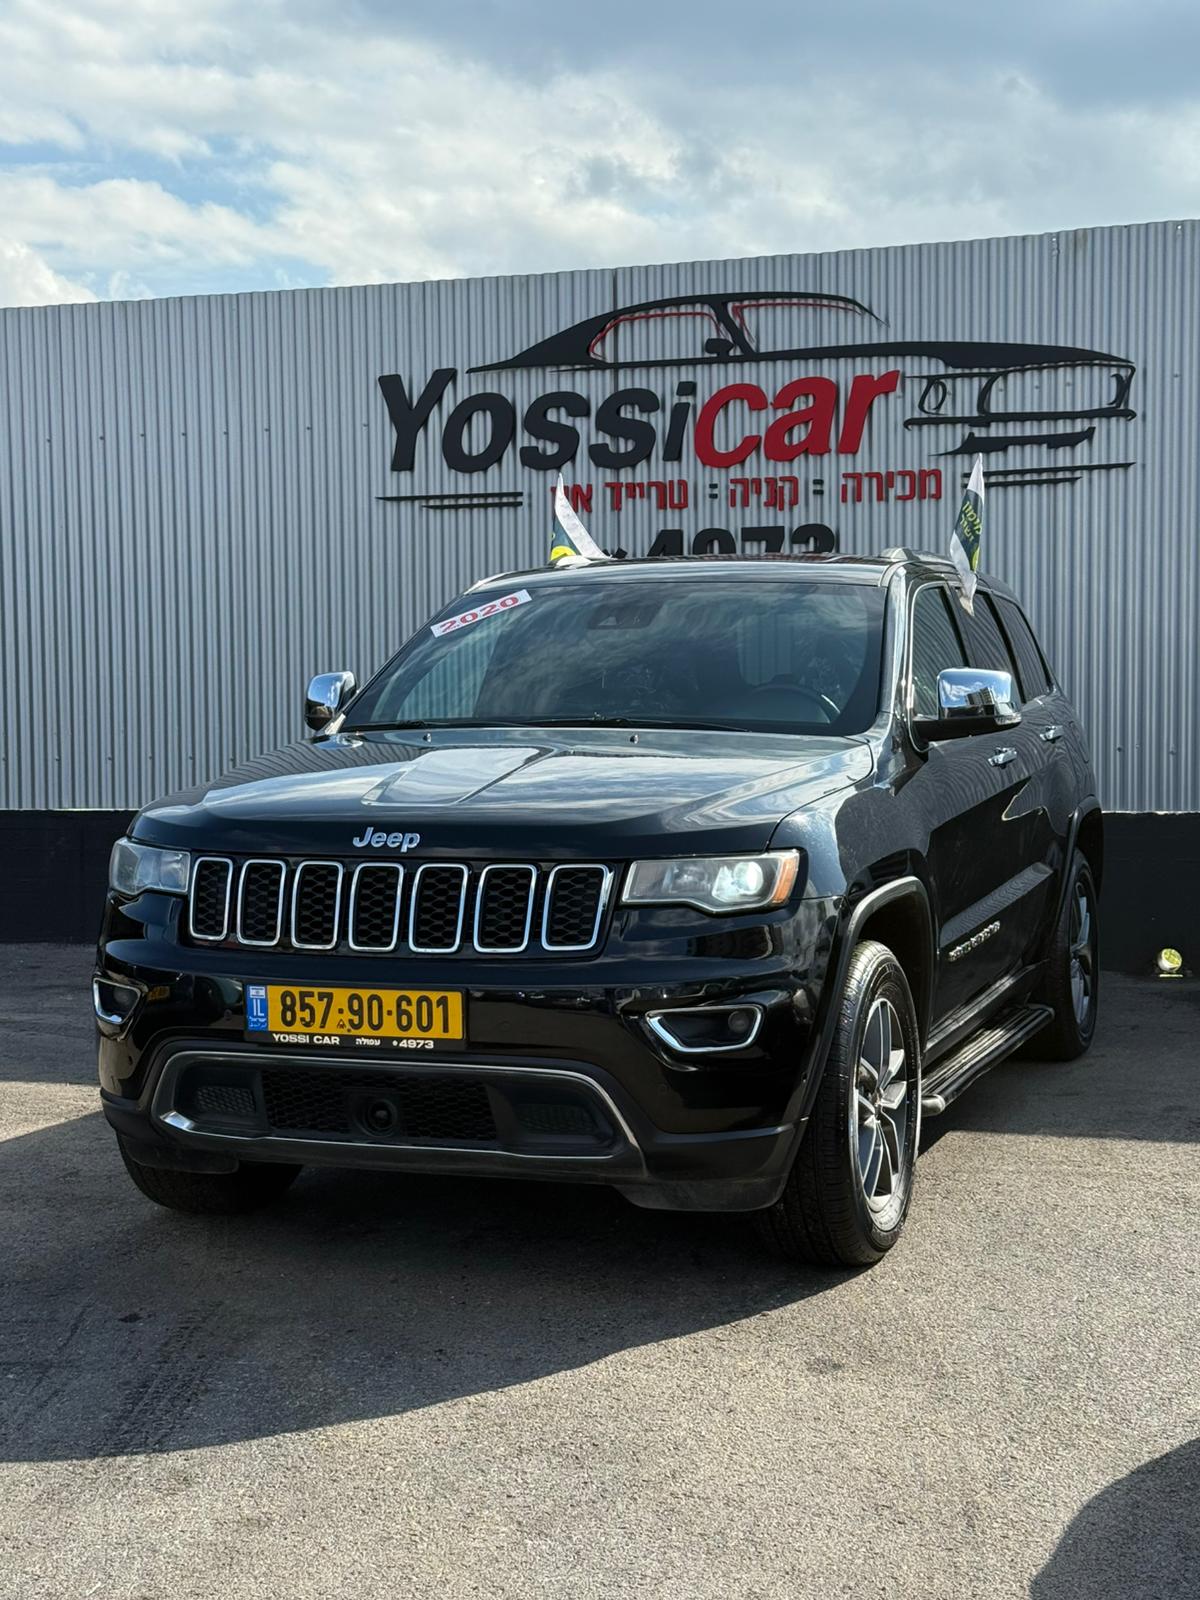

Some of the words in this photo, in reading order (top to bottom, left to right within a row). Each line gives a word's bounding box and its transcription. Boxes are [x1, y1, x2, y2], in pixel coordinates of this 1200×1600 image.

[603, 479, 689, 511] טרייד
[729, 475, 799, 511] קניה
[841, 469, 942, 503] מכירה
[439, 596, 520, 633] 2020
[352, 826, 421, 853] Jeep
[253, 998, 265, 1017] IL
[272, 1033, 310, 1044] YOSSI
[313, 1035, 340, 1045] CAR
